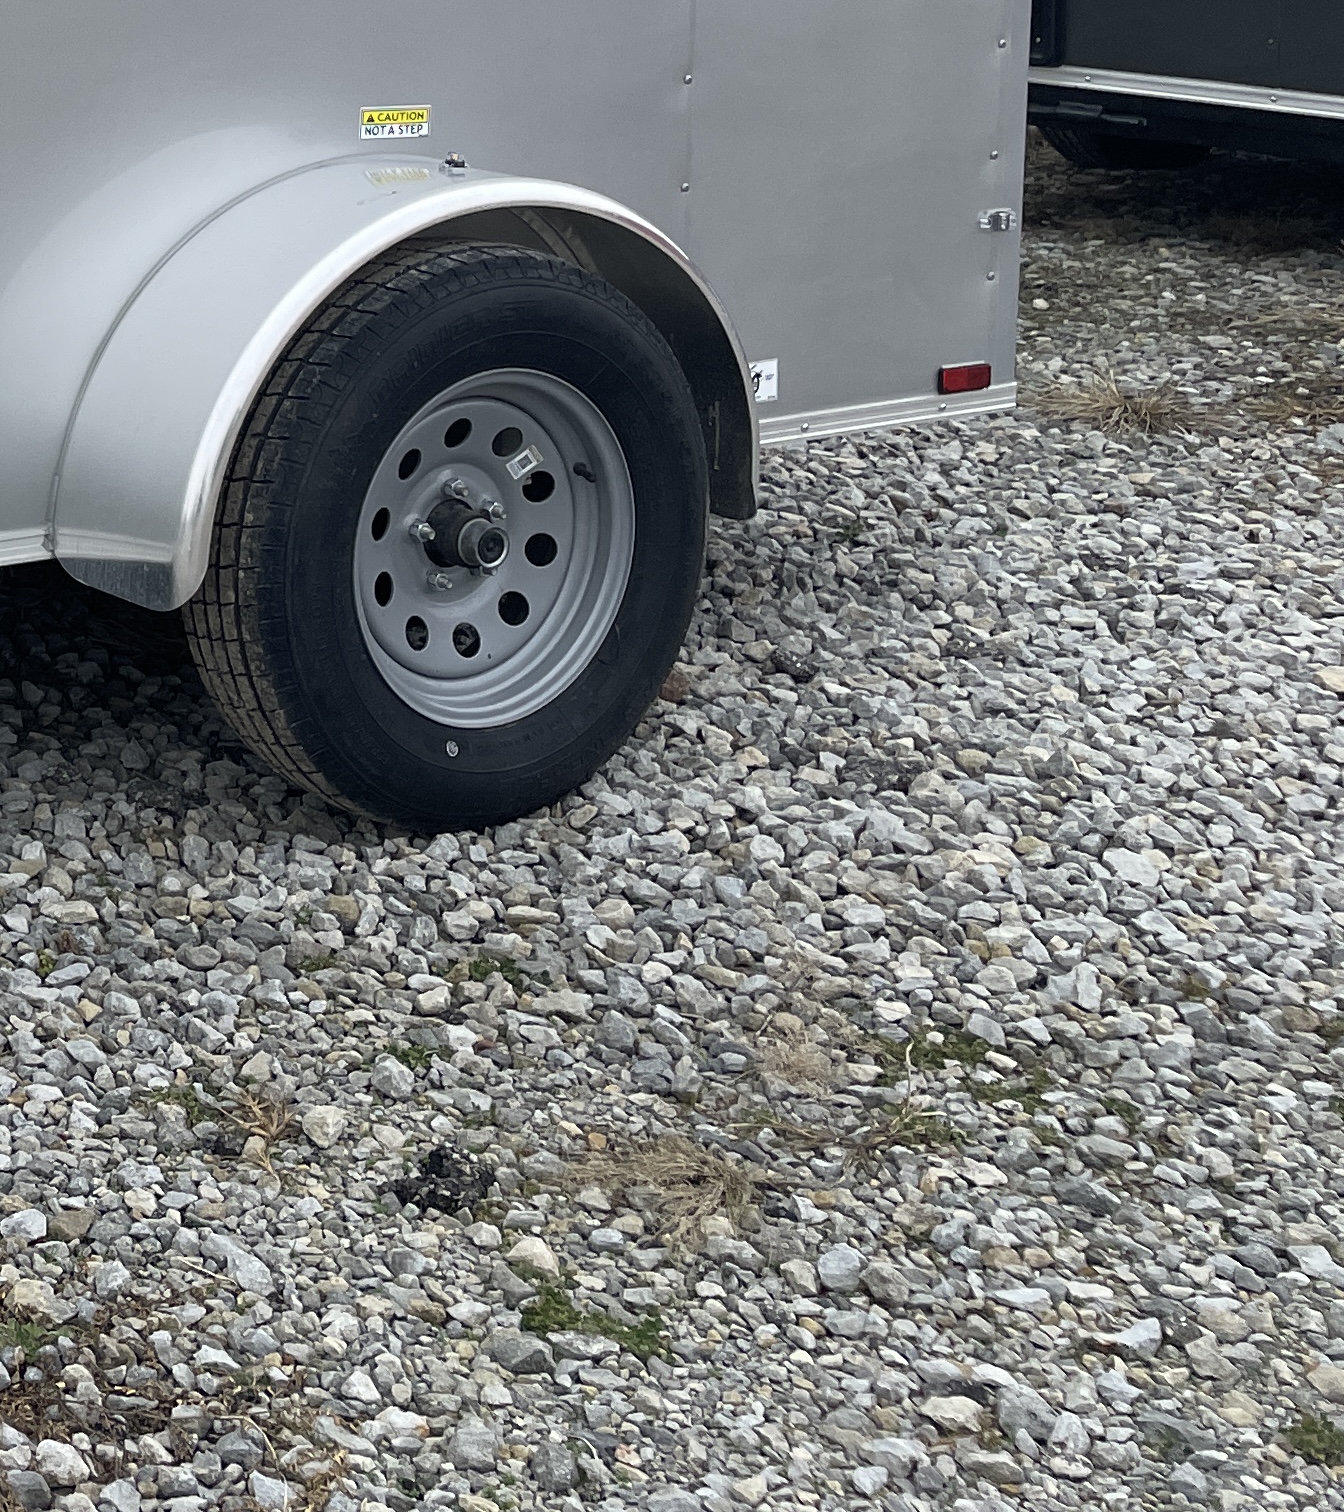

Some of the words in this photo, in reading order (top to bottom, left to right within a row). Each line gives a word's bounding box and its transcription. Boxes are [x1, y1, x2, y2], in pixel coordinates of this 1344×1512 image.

[377, 111, 425, 122] CAUTION
[365, 125, 386, 136] NOT
[387, 125, 395, 135] A
[398, 124, 423, 135] STEP
